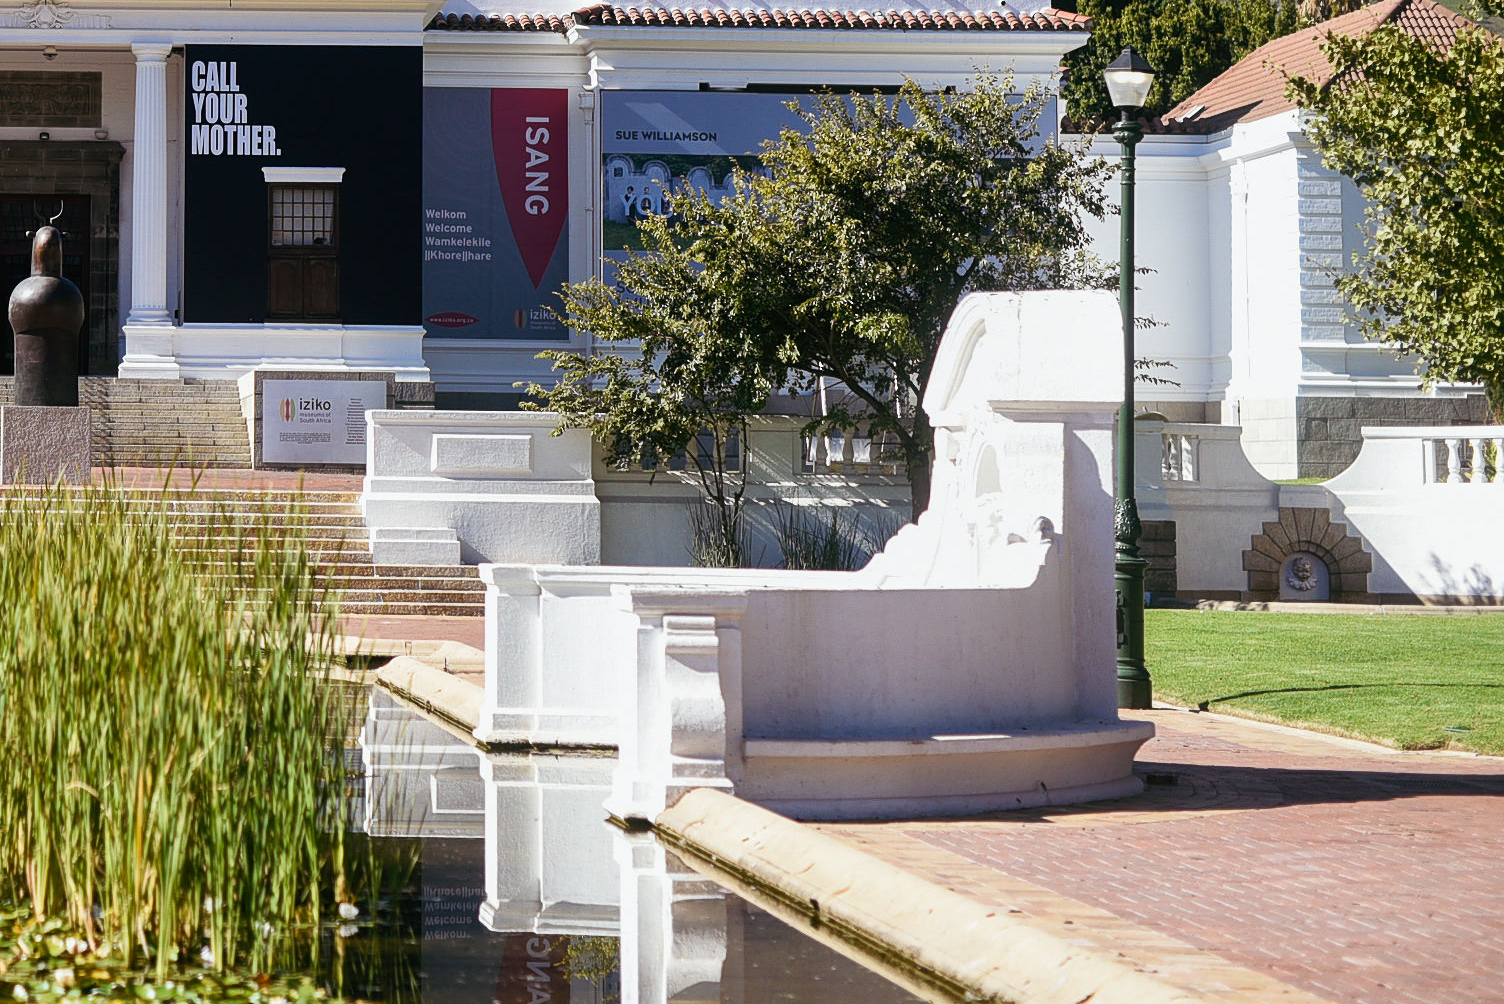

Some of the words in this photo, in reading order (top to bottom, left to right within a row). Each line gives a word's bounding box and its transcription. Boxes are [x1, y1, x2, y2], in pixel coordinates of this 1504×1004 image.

[191, 60, 240, 92] CALL
[192, 93, 248, 124] YOUR
[191, 124, 282, 156] MOTHER.
[615, 130, 639, 140] SUE
[640, 131, 717, 142] WILLIAMSON
[524, 116, 550, 215] ISANG
[425, 209, 467, 219] Welkom
[425, 223, 473, 233] Welcome
[425, 236, 492, 247] Wamkelekile
[530, 308, 556, 320] iziko
[299, 398, 332, 411] iziko
